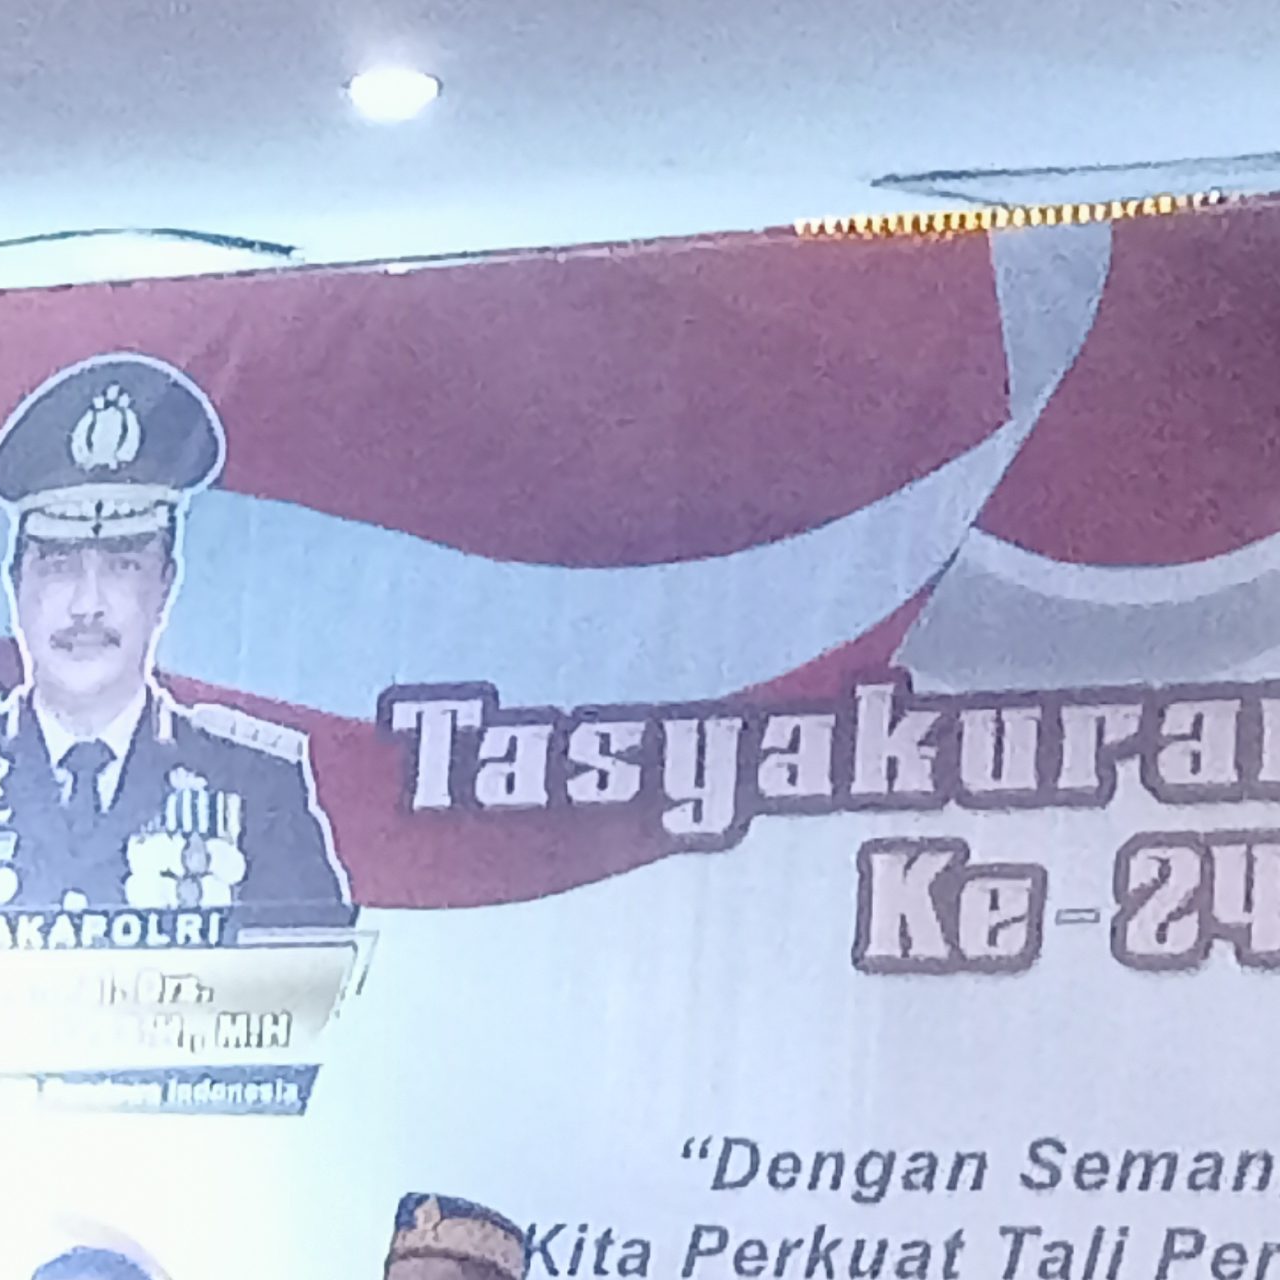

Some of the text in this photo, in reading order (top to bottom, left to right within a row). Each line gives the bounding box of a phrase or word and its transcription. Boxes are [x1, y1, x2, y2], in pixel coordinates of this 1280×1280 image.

[388, 680, 1280, 836] Tasyakura
[521, 1221, 652, 1279] Kita
[680, 1223, 966, 1280] Perkuat
